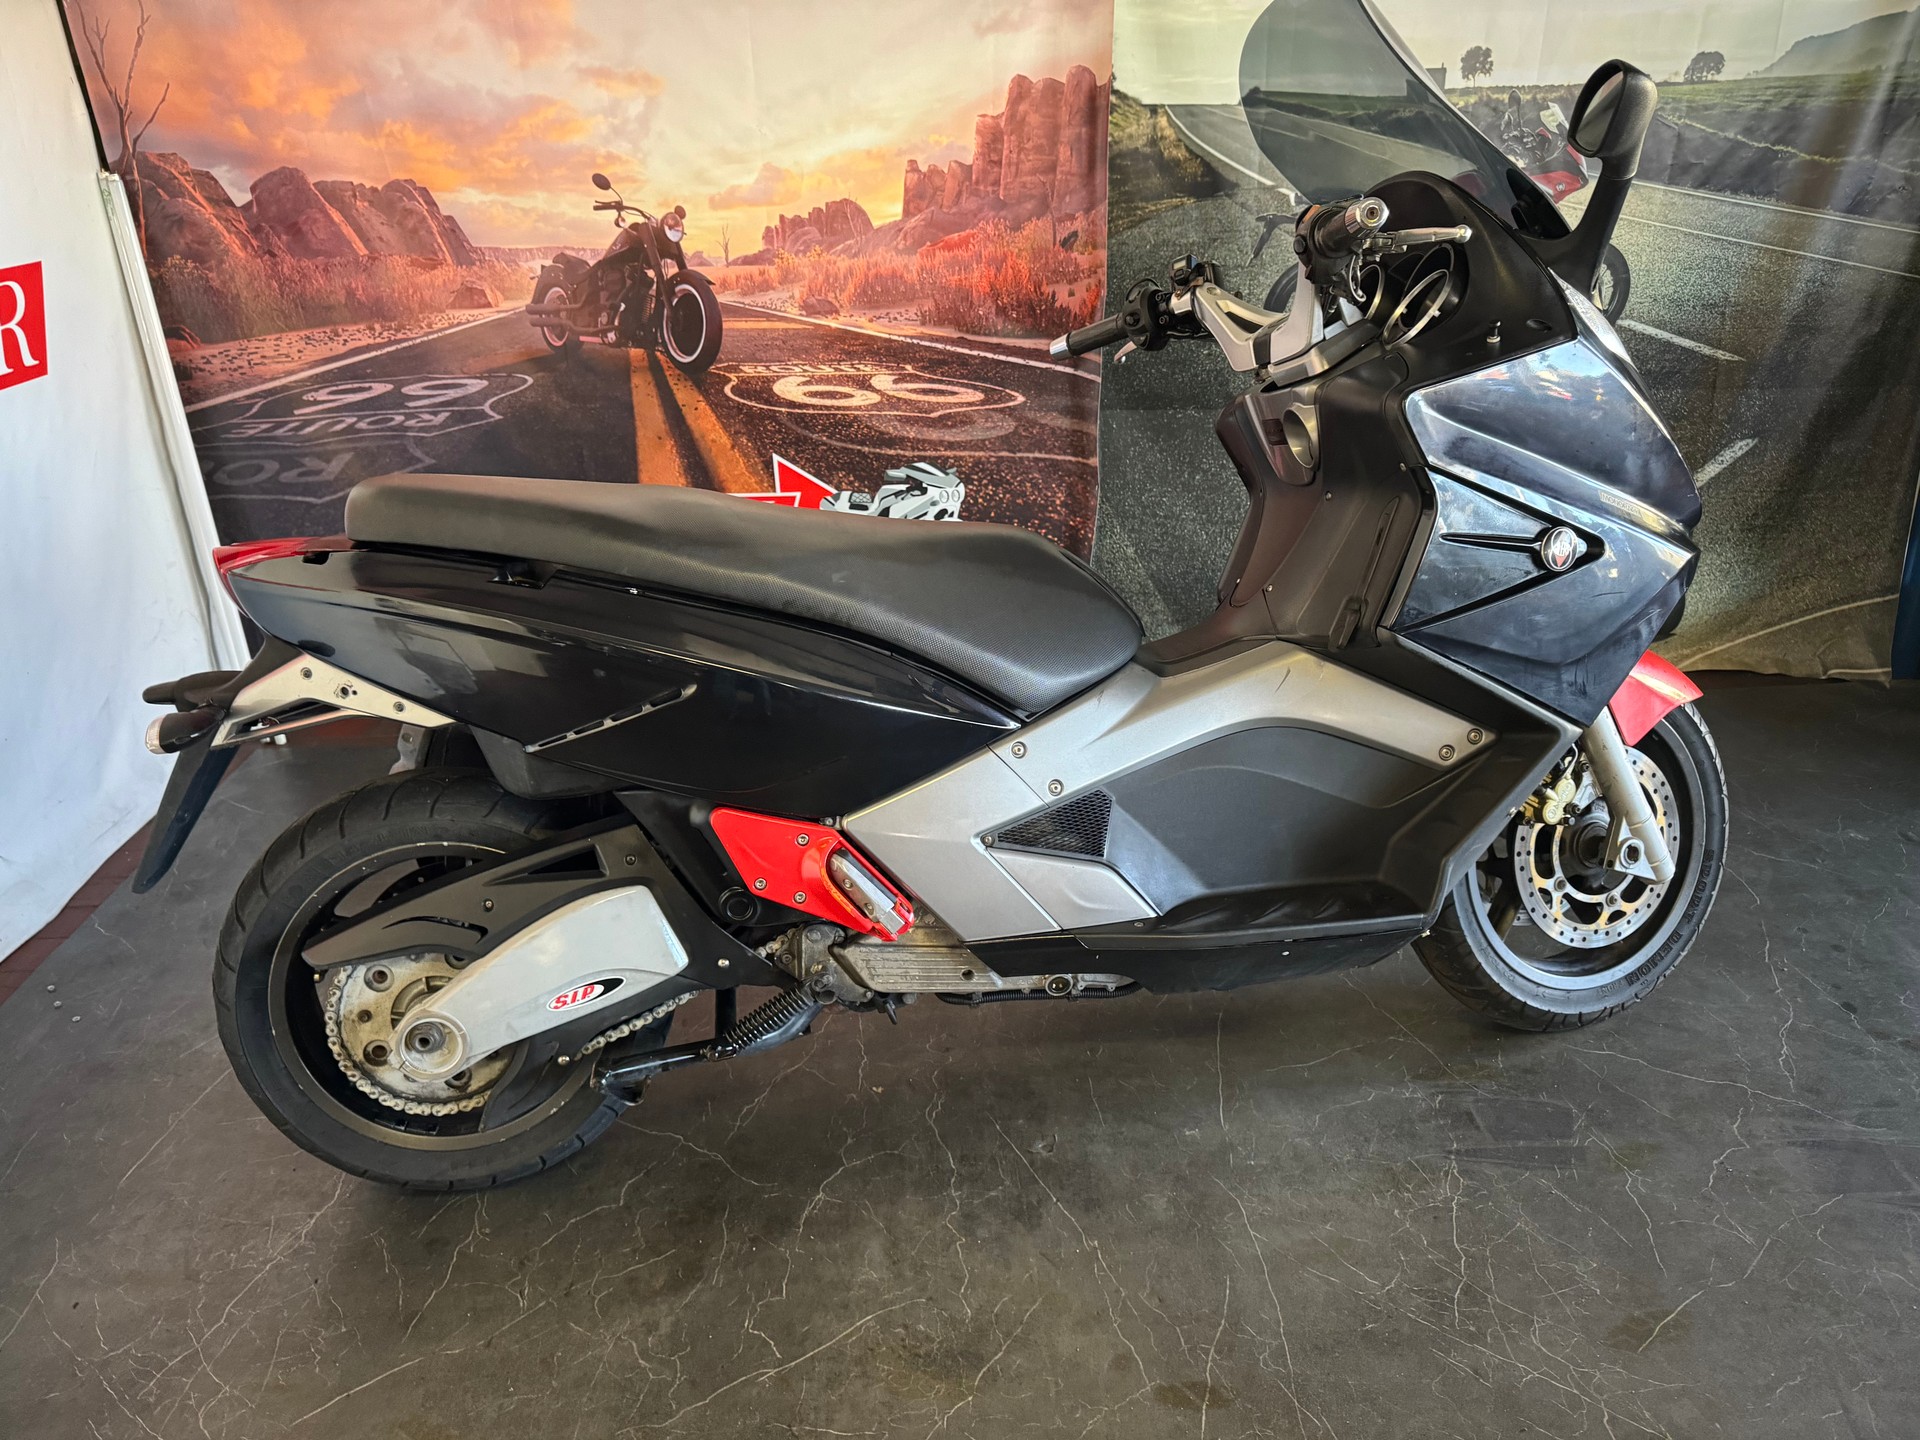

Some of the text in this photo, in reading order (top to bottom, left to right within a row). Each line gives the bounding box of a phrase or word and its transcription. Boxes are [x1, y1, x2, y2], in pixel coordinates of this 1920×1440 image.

[738, 364, 886, 373] ROUTE
[772, 374, 985, 407] 66
[220, 411, 452, 439] ROUTE
[203, 452, 355, 487] RO
[1625, 849, 1715, 987] SPORT DEMON
